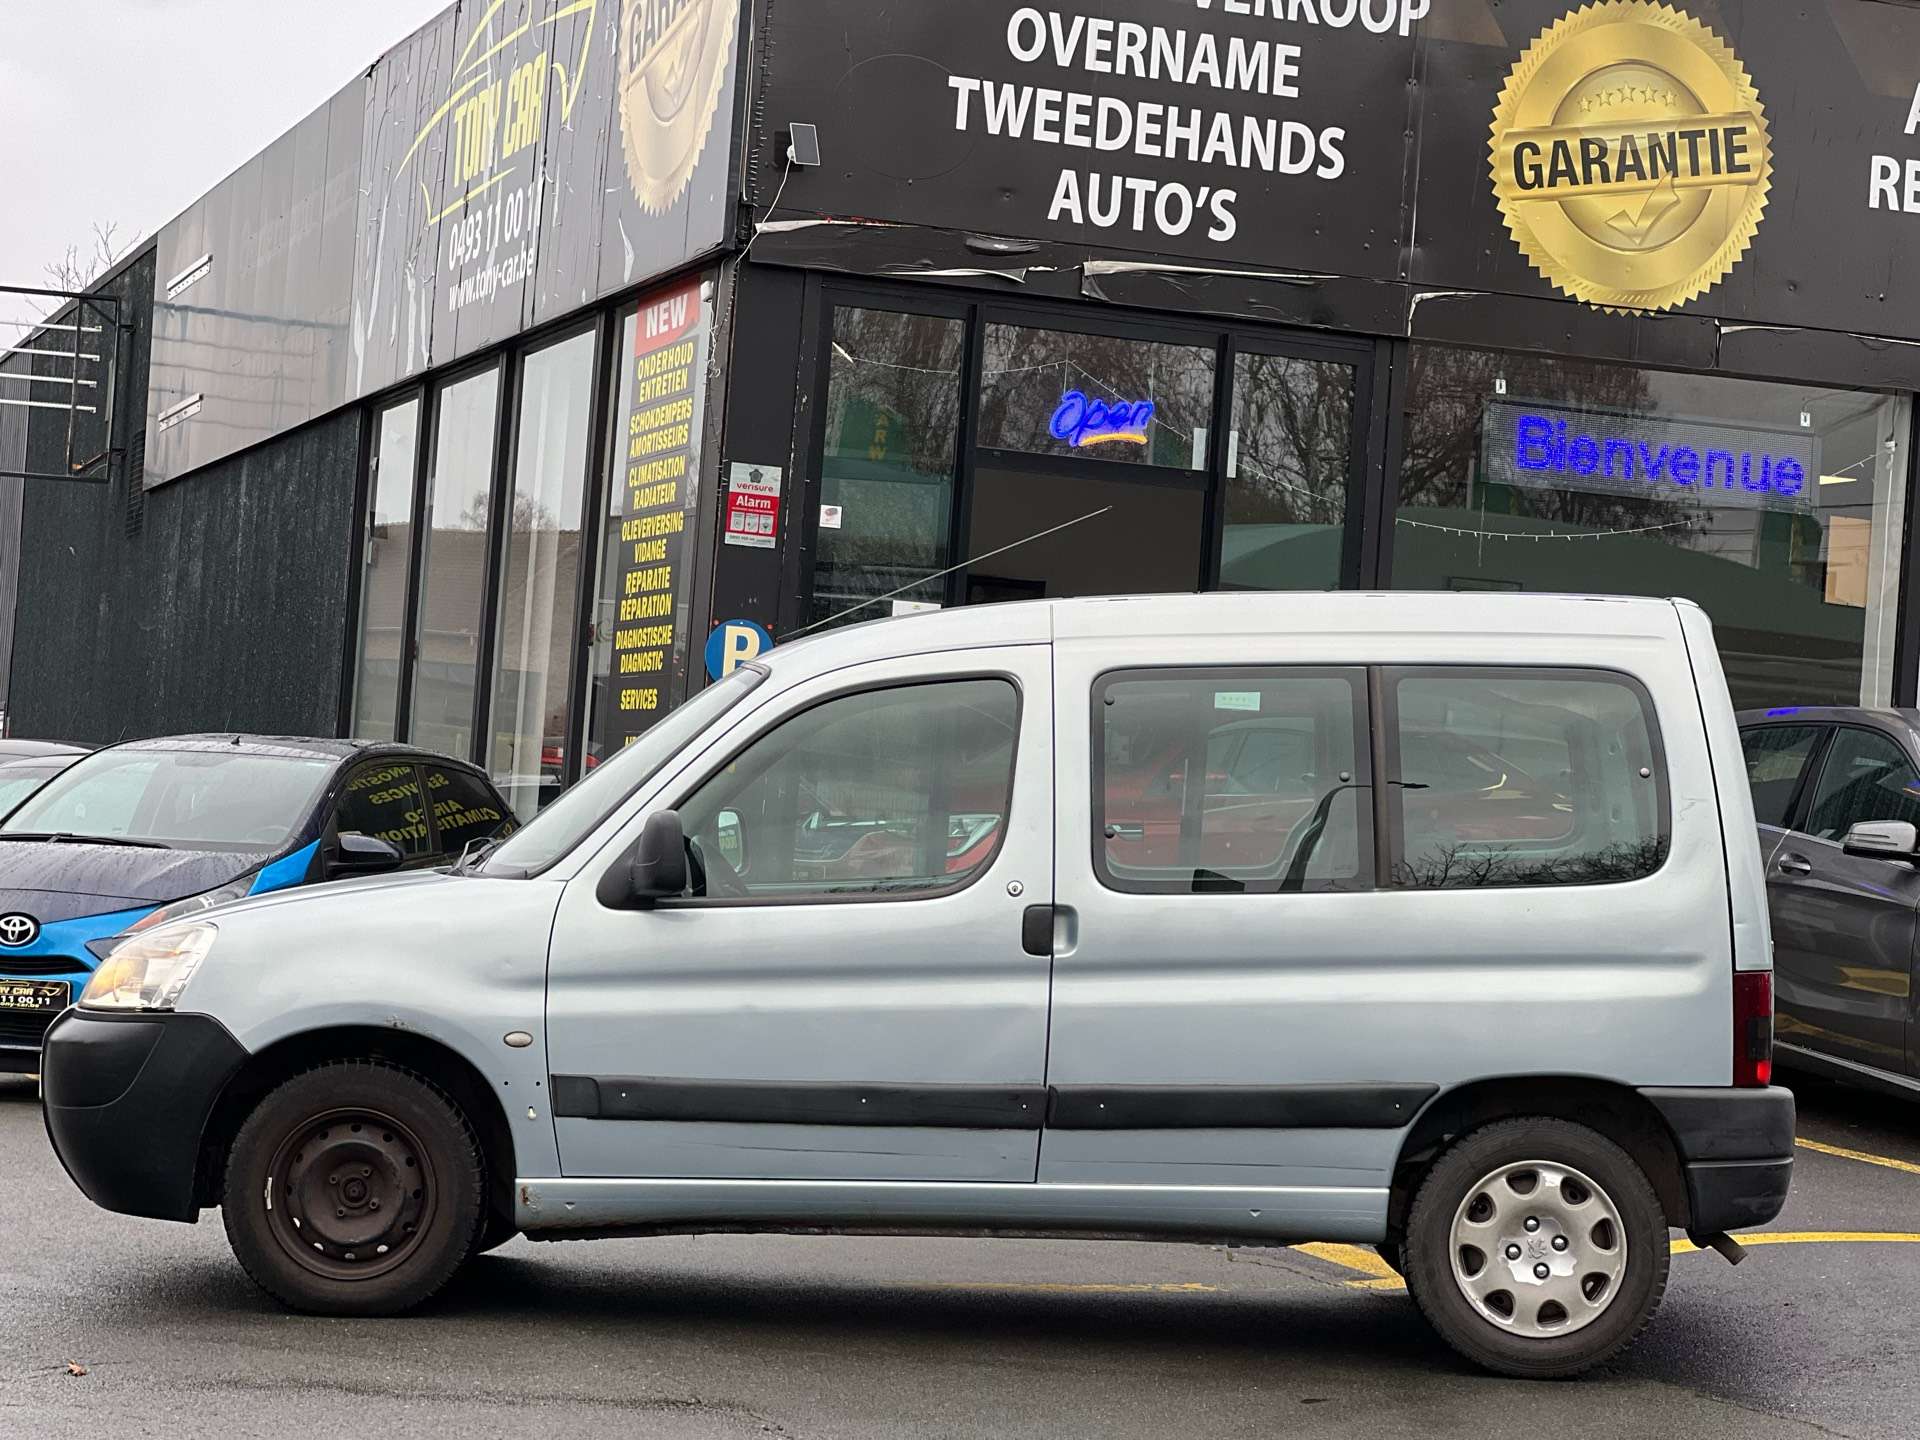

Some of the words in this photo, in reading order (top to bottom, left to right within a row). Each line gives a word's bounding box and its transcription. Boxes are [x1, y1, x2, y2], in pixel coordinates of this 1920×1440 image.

[1006, 7, 1302, 98] OVERNAME
[454, 79, 501, 188] TONY
[502, 51, 548, 160] CAR
[948, 75, 1346, 180] TWEEDEHANDS
[1512, 126, 1752, 191] GARANTIE
[1047, 169, 1238, 242] AUTO'S
[449, 208, 482, 271] 0493
[486, 198, 501, 252] 11
[504, 187, 524, 243] 00
[449, 240, 535, 313] www.tony-car.be
[646, 294, 688, 339] NEW
[637, 341, 694, 381] ONDERHOUD
[639, 367, 688, 404] ENTRETIEN
[629, 397, 693, 436] SCHOKDEMPERS
[1049, 388, 1154, 448] Open
[629, 422, 689, 459] AMORTISSEURS
[1516, 414, 1804, 496] Bienvenue
[628, 454, 686, 488] CLIMATISATION
[736, 482, 774, 493] verisure
[633, 481, 677, 511] RADIATEUR
[735, 495, 772, 509] Alarm
[621, 510, 685, 542] OLIEVERVERSING
[634, 538, 667, 564] VIDANGE
[625, 565, 671, 595] REPARATIE
[620, 592, 672, 622] RÉPARATION
[615, 623, 673, 651] DIAGNOSTISCHE
[722, 624, 760, 682] P
[620, 650, 664, 674] DIAGNOSTIC
[620, 688, 658, 711] SERVICES
[17, 996, 34, 1004] 00
